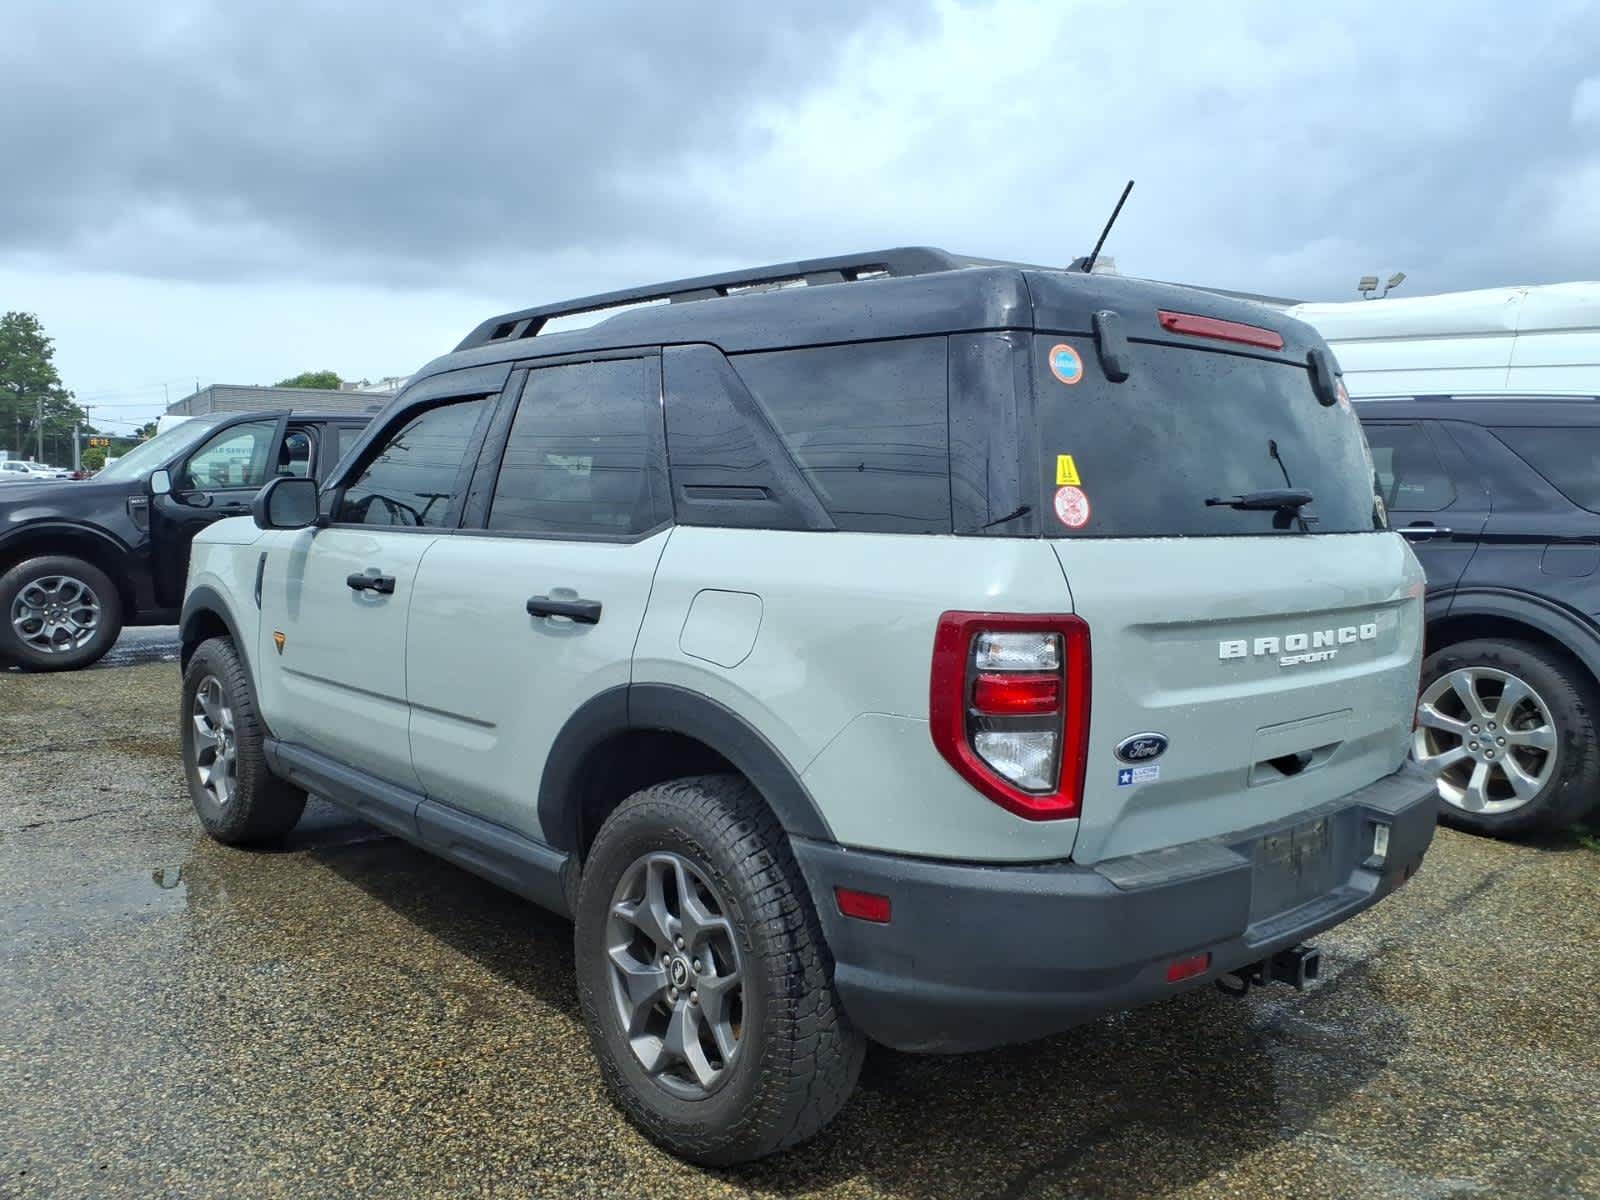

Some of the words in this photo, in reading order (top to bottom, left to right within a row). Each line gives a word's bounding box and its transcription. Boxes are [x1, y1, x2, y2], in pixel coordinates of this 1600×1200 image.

[1219, 623, 1377, 660] BRONCO
[1279, 649, 1339, 667] SPORT
[1129, 740, 1160, 758] Ford
